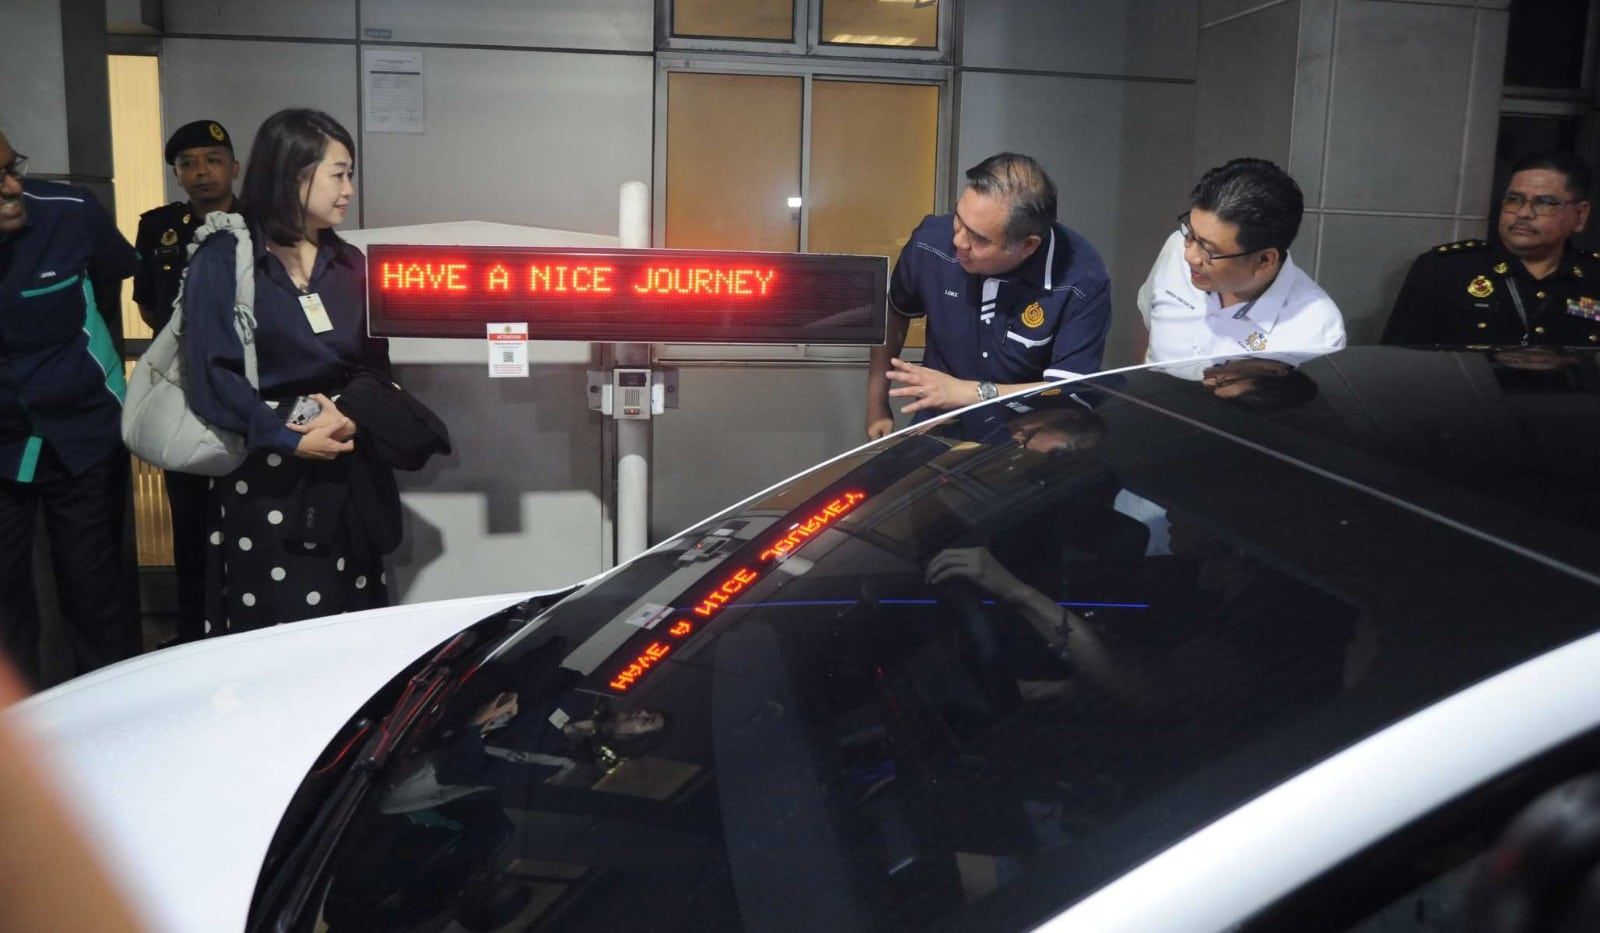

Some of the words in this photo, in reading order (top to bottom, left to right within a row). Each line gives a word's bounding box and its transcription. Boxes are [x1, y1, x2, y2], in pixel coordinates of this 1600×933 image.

[381, 262, 468, 291] HAVE
[488, 264, 511, 292] A
[529, 265, 614, 294] NICE
[633, 266, 776, 296] JOURNEY
